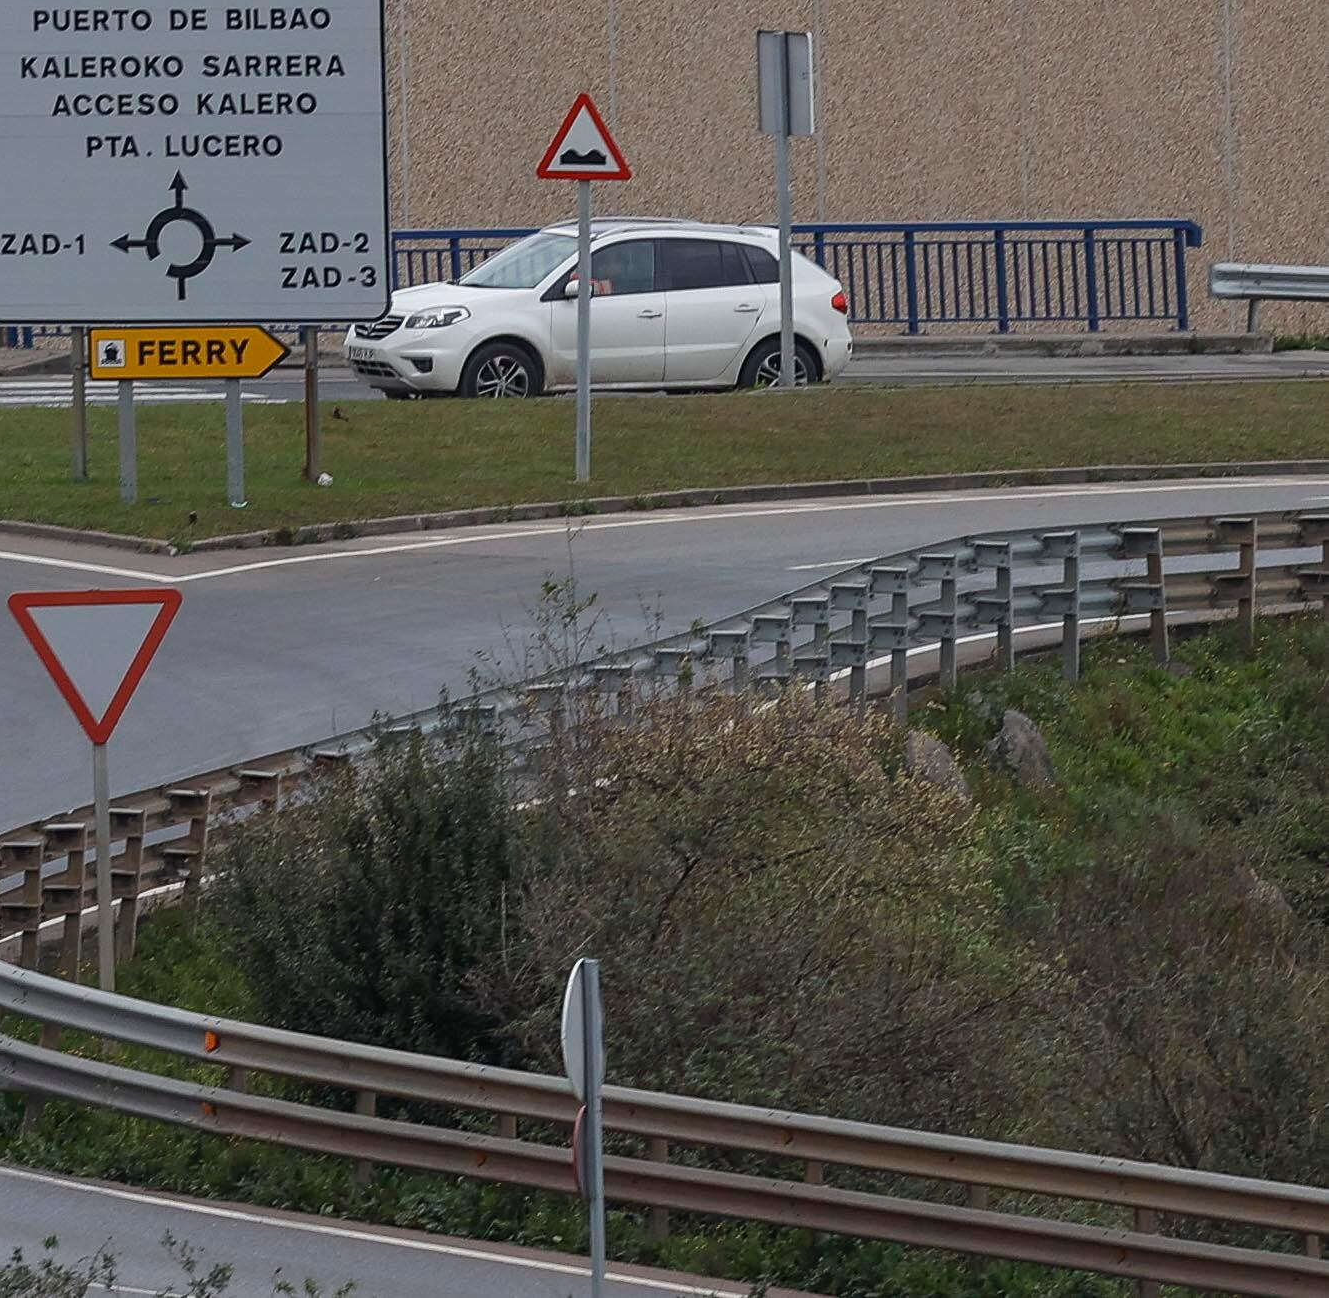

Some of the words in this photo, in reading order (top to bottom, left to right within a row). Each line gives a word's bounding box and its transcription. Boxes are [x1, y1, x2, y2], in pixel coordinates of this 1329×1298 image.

[33, 9, 152, 32] PUERTO
[169, 9, 208, 31] DE
[226, 7, 331, 31] BILBAO
[21, 55, 184, 79] KALEROKO
[202, 55, 345, 78] SARRERA
[51, 93, 179, 117] ACCESO
[197, 92, 317, 113] KALERO
[86, 135, 152, 158] PTA.
[165, 134, 283, 157] LUCERO
[1, 233, 84, 255] ZAD-1
[279, 232, 369, 254] ZAD-2
[281, 266, 377, 289] ZAD-3
[138, 338, 249, 366] FERRY
